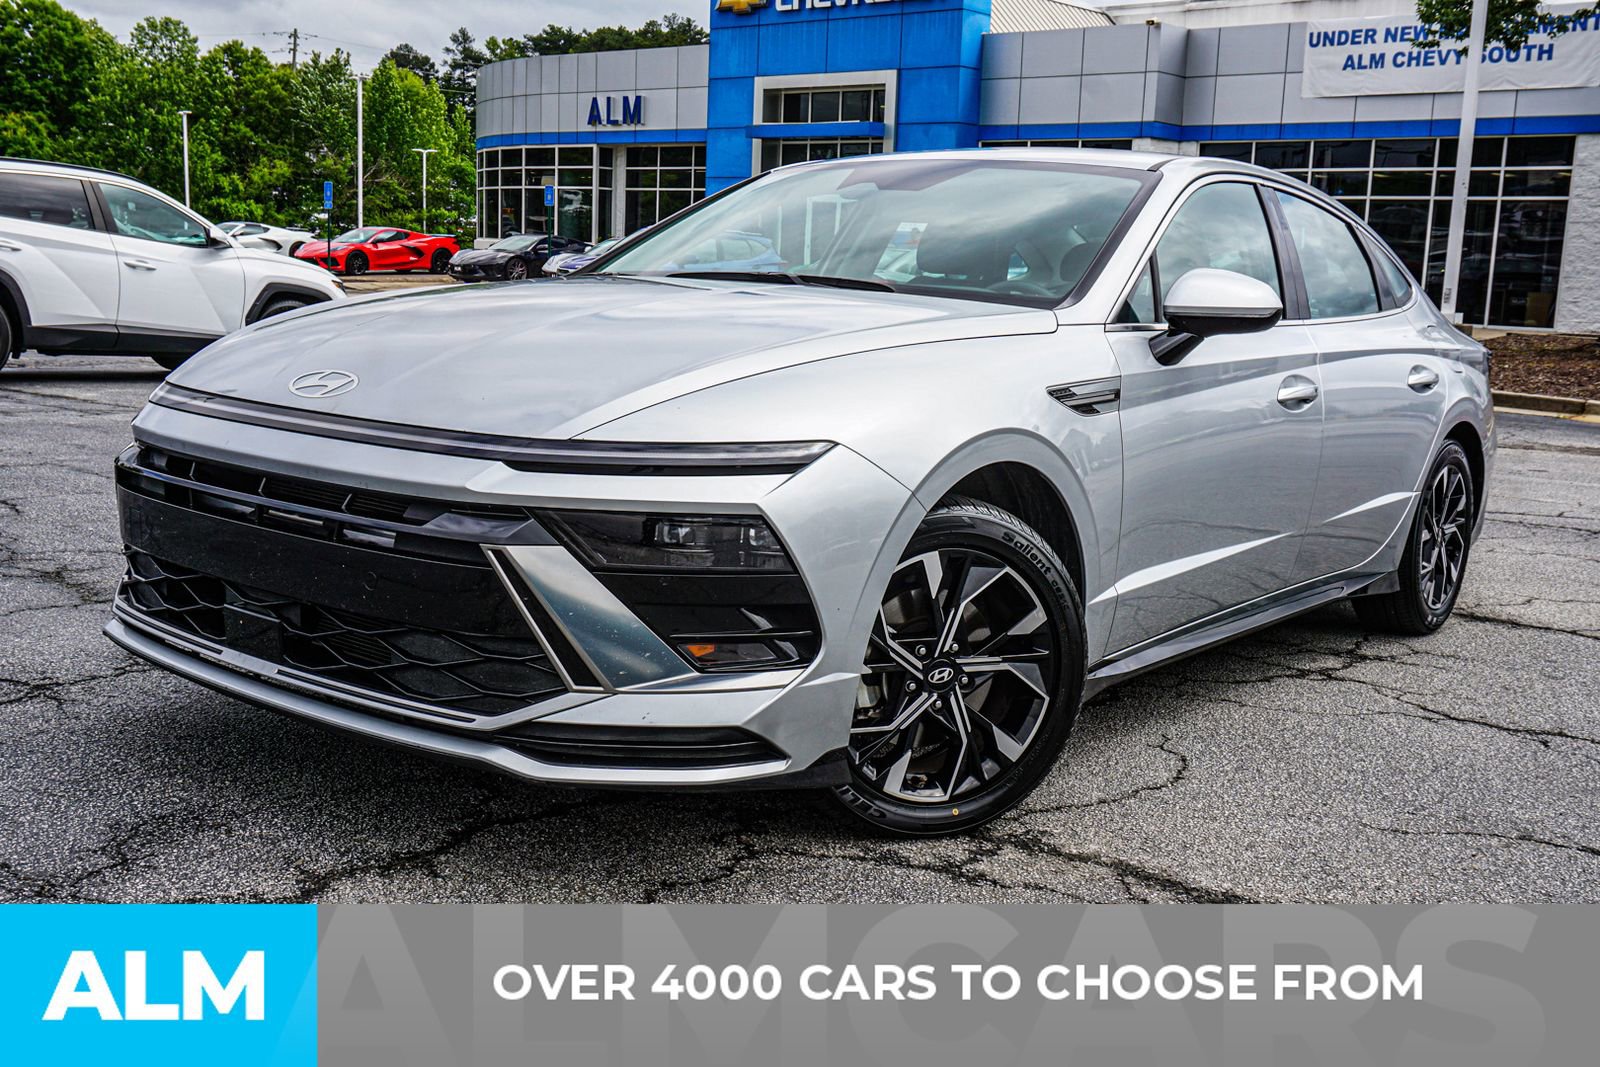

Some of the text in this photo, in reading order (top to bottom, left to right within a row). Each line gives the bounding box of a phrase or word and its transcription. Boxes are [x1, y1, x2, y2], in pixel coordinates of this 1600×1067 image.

[1308, 28, 1377, 48] UNDER
[1384, 25, 1432, 43] NEW
[1342, 52, 1386, 71] ALM
[1392, 48, 1465, 68] CHEVY
[587, 95, 643, 126] ALM
[1001, 531, 1051, 575] Salient
